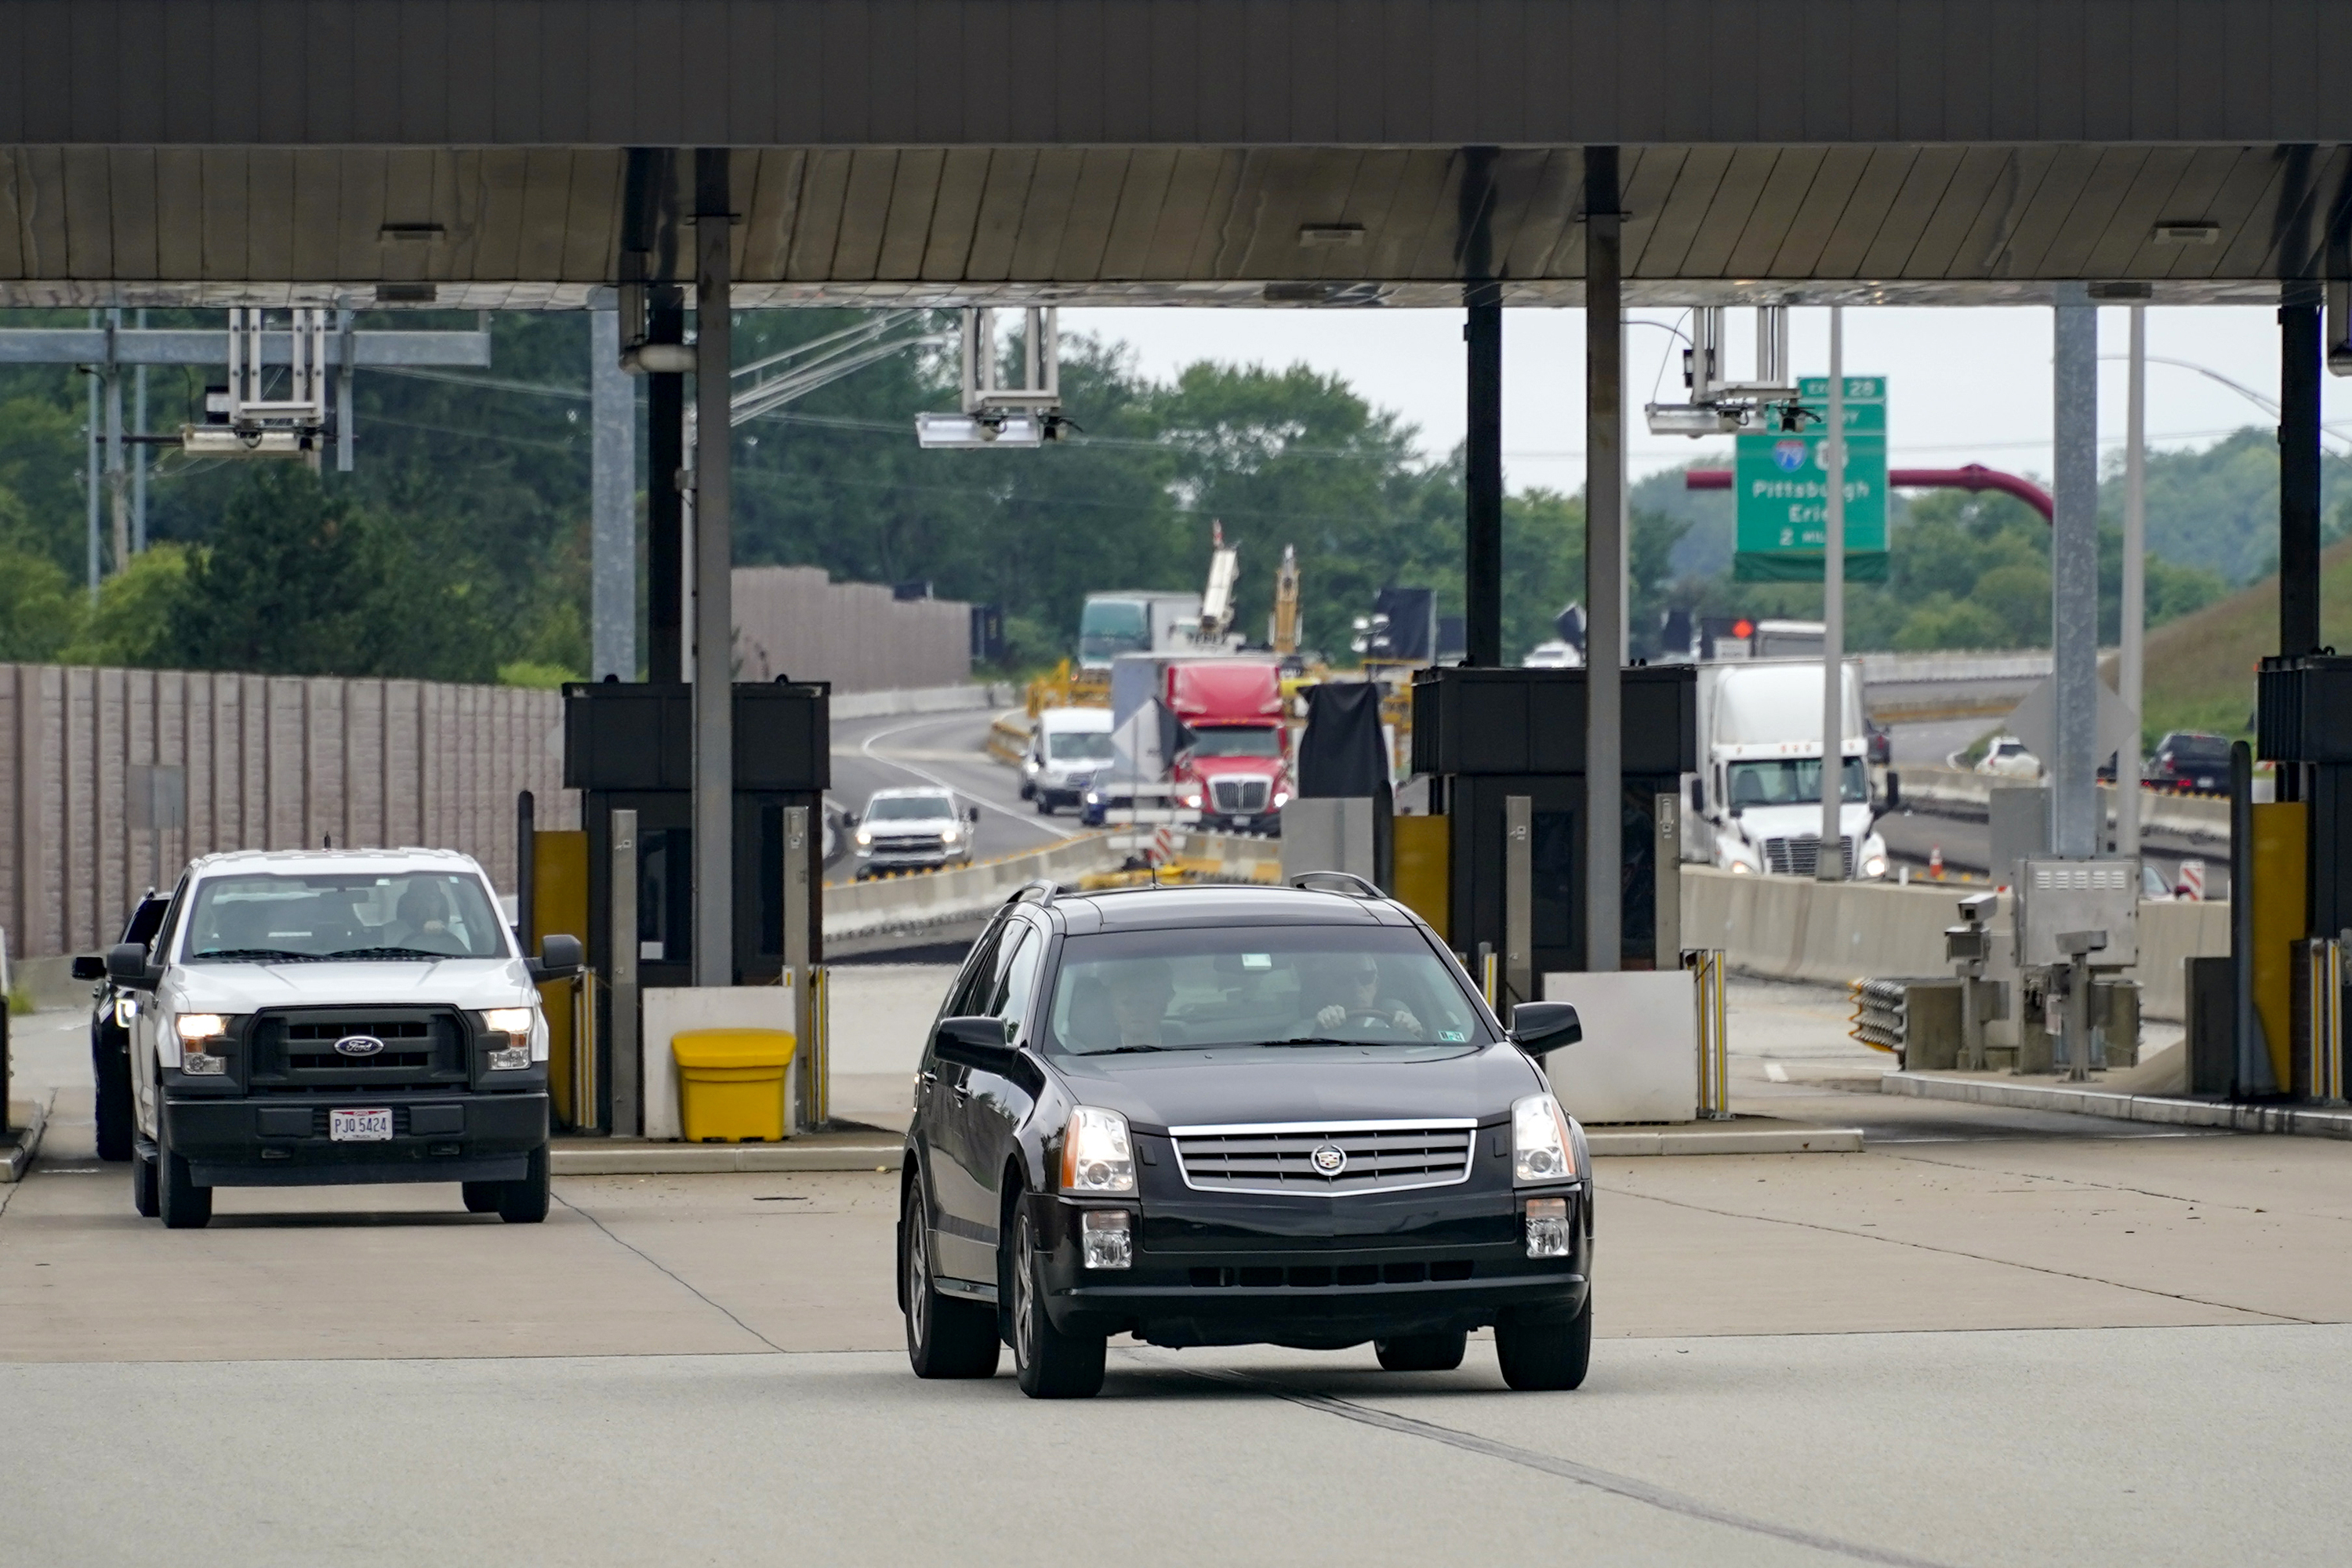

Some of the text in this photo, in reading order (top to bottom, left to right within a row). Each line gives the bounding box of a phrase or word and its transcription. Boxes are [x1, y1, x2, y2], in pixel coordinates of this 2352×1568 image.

[1780, 528, 1794, 546] 2
[347, 1040, 372, 1051] Ford
[359, 1117, 387, 1132] 5424
